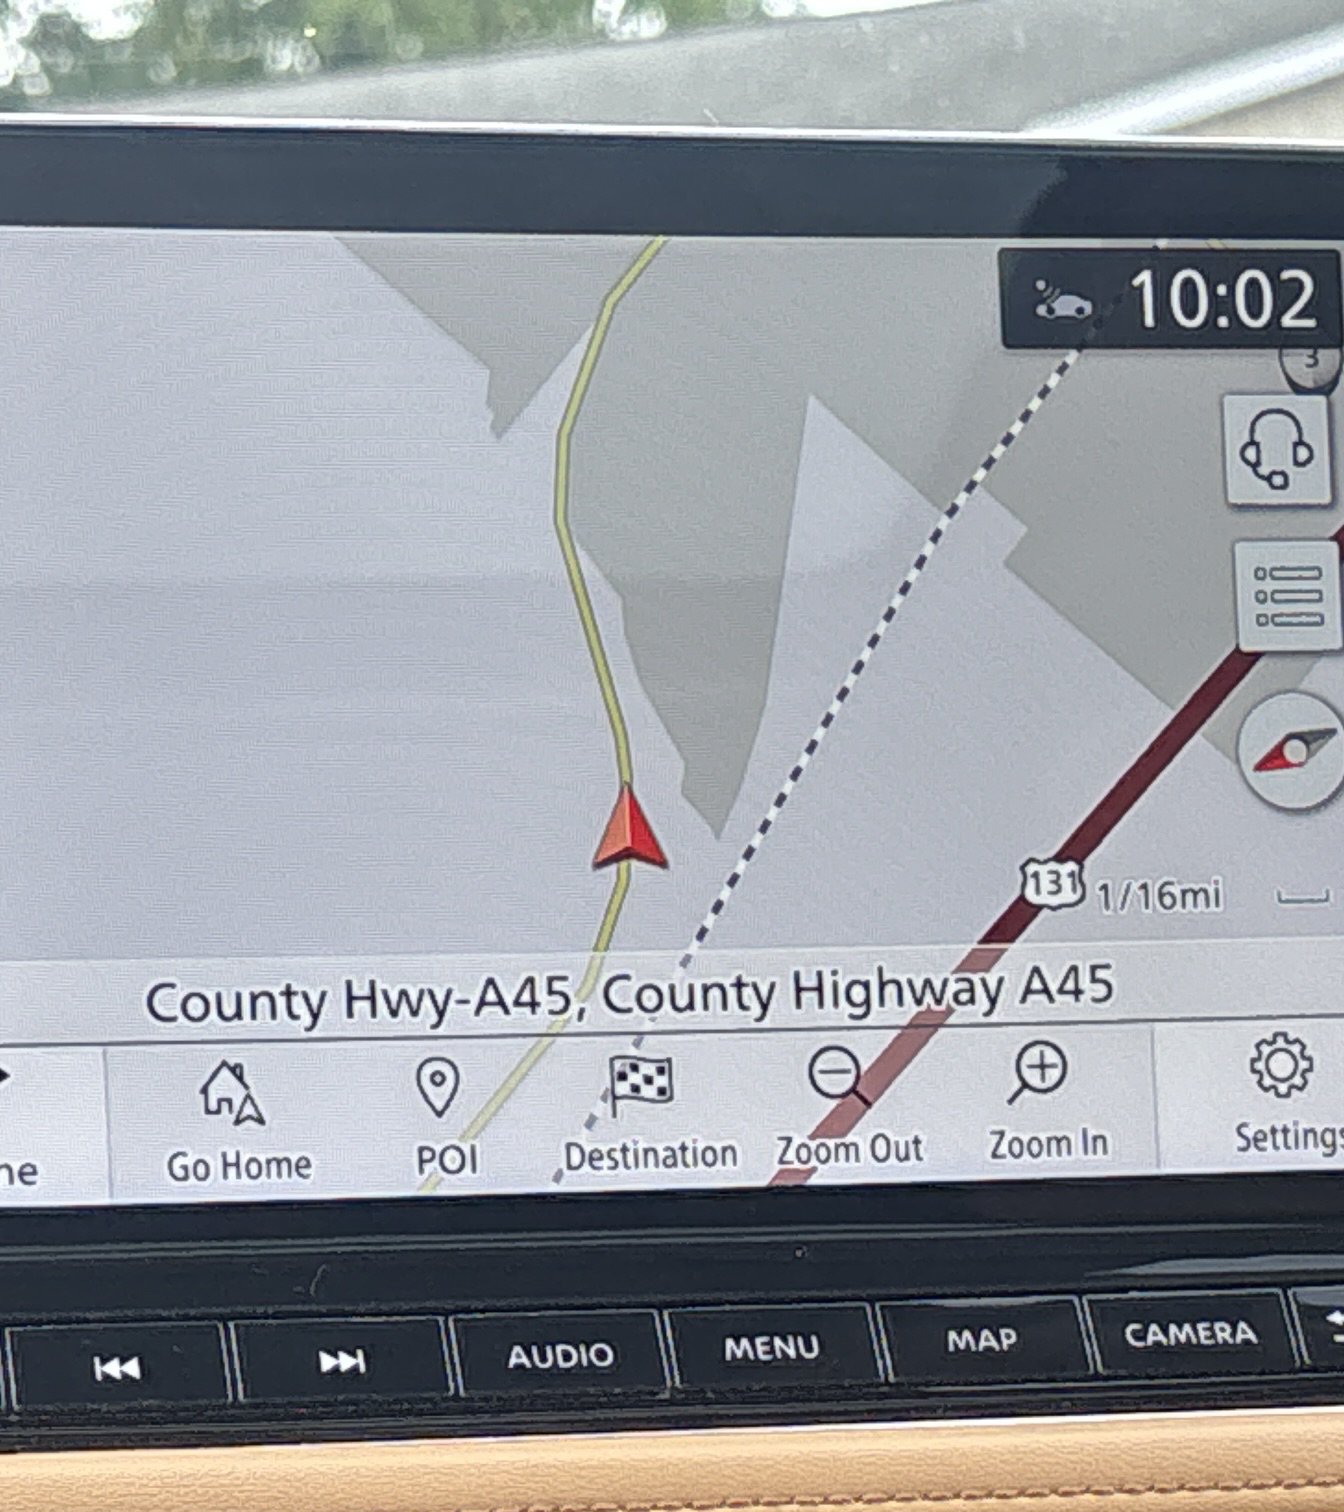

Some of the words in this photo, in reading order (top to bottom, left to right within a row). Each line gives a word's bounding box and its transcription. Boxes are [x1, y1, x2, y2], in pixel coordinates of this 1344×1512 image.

[1131, 268, 1317, 328] 10:02
[1029, 869, 1078, 896] 131
[1098, 880, 1220, 911] 1/16mi
[146, 982, 327, 1032] County
[345, 975, 586, 1030] Hwy-A45,
[603, 973, 776, 1023] County
[793, 964, 1006, 1022] Highway
[1019, 963, 1113, 1004] A45
[564, 1138, 738, 1171] Destination
[776, 1135, 861, 1166] Zoom
[869, 1132, 924, 1164] Out
[989, 1129, 1072, 1160] Zoom
[1081, 1127, 1108, 1156] In
[167, 1151, 211, 1182] Go
[221, 1150, 312, 1181] Home
[417, 1144, 477, 1175] POI
[725, 1335, 819, 1361] MENU
[948, 1328, 1017, 1352] MAP
[1125, 1321, 1258, 1347] CAMERA
[508, 1343, 614, 1369] AUDIO
